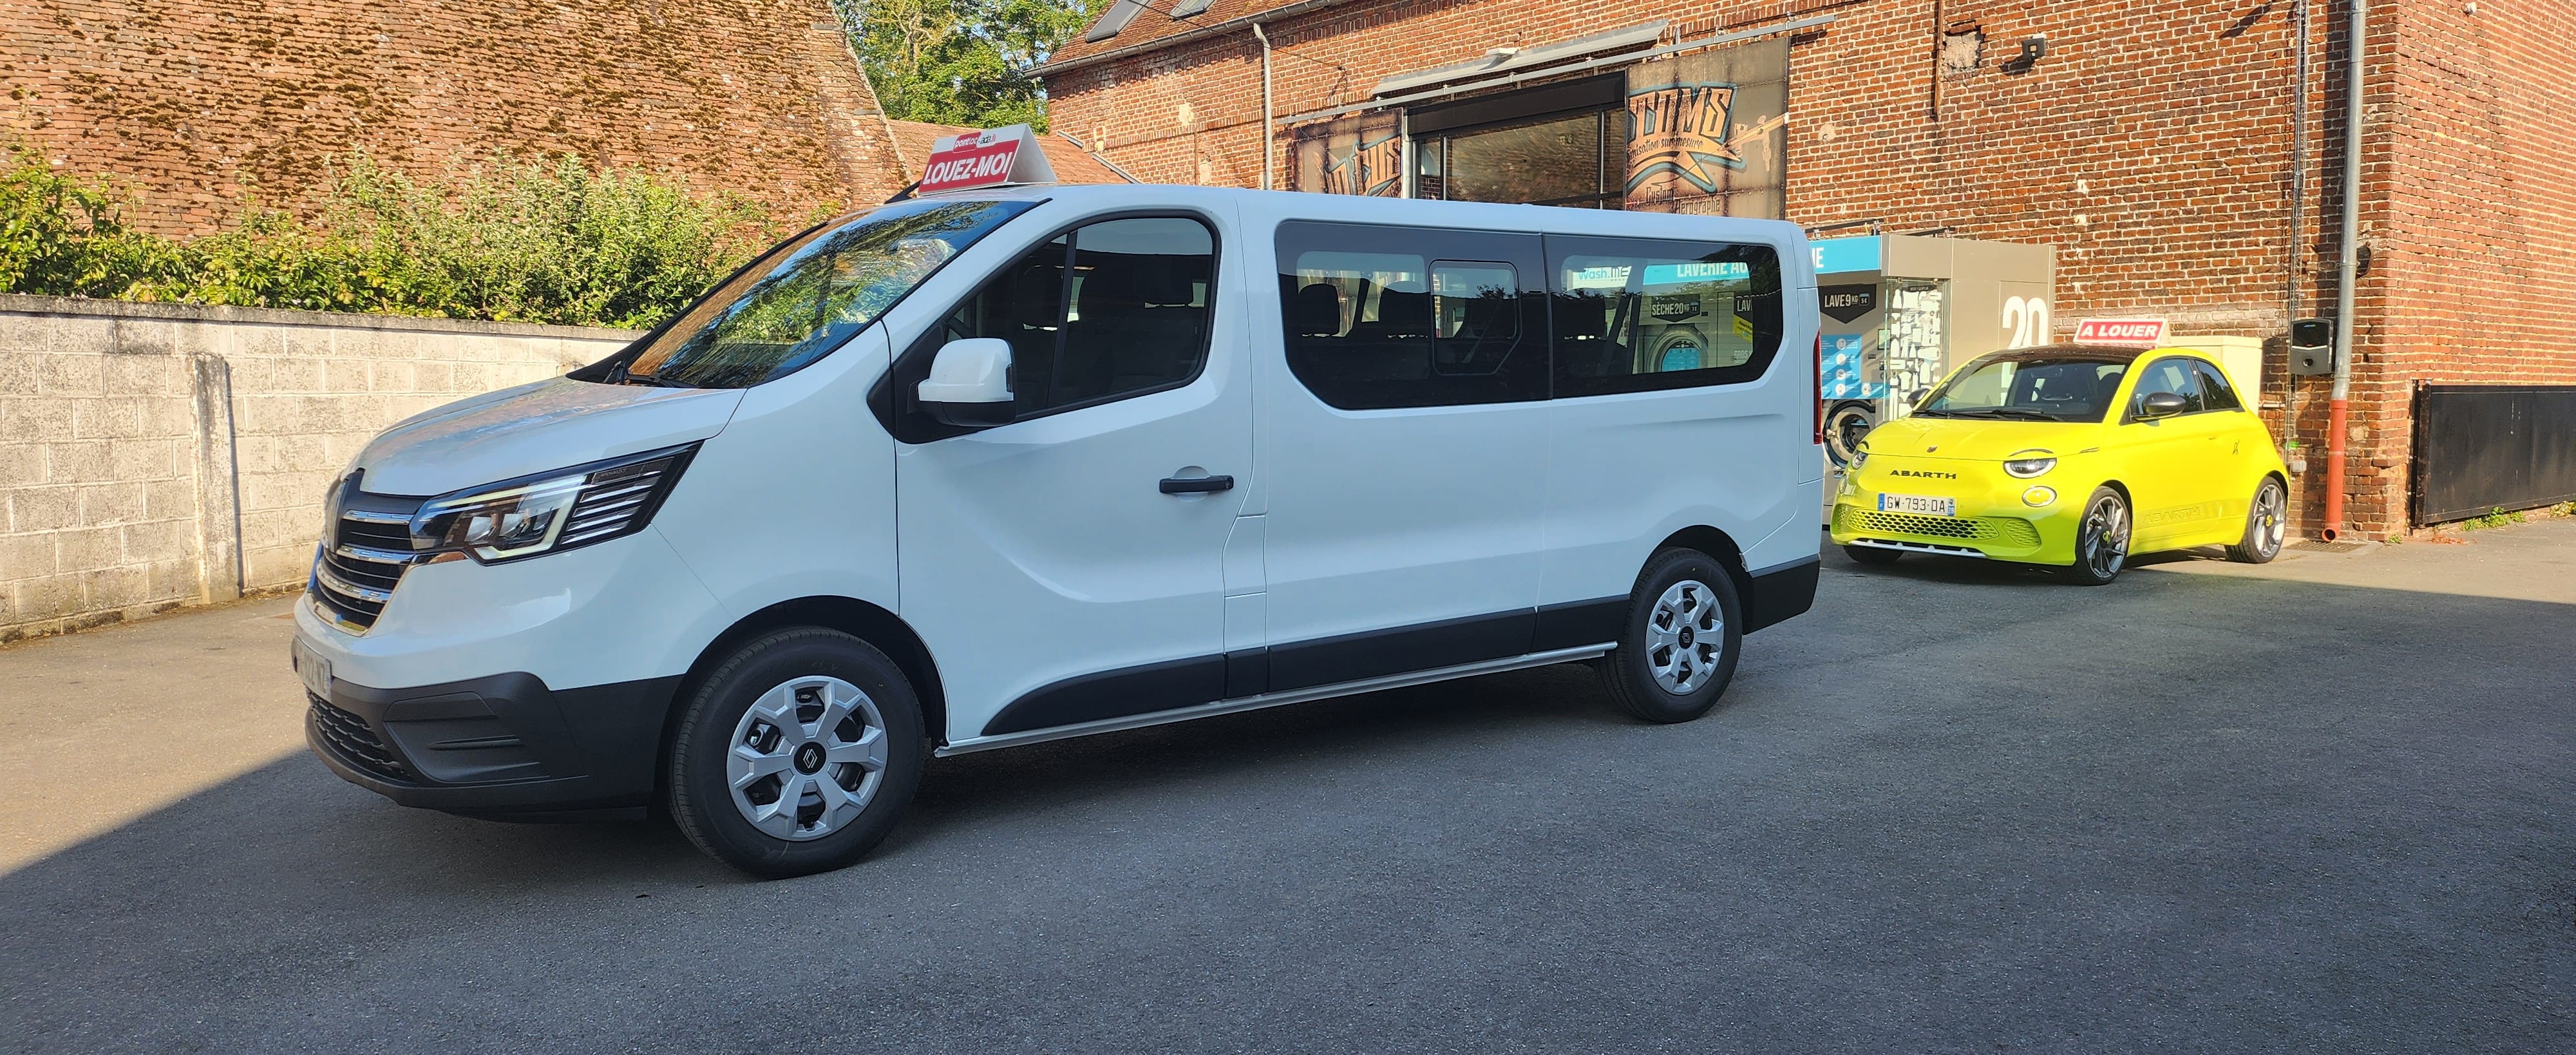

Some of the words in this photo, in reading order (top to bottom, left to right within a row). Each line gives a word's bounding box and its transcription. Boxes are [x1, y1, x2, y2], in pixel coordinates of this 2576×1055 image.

[922, 151, 1013, 185] LOUEZ-MOI
[1677, 262, 1728, 278] LAVERIE
[1737, 299, 1752, 312] LAV
[2081, 325, 2093, 337] A
[2097, 324, 2158, 337] LOUER
[1889, 470, 1957, 480] ABARTH
[1887, 496, 1946, 513] GW-793-DA
